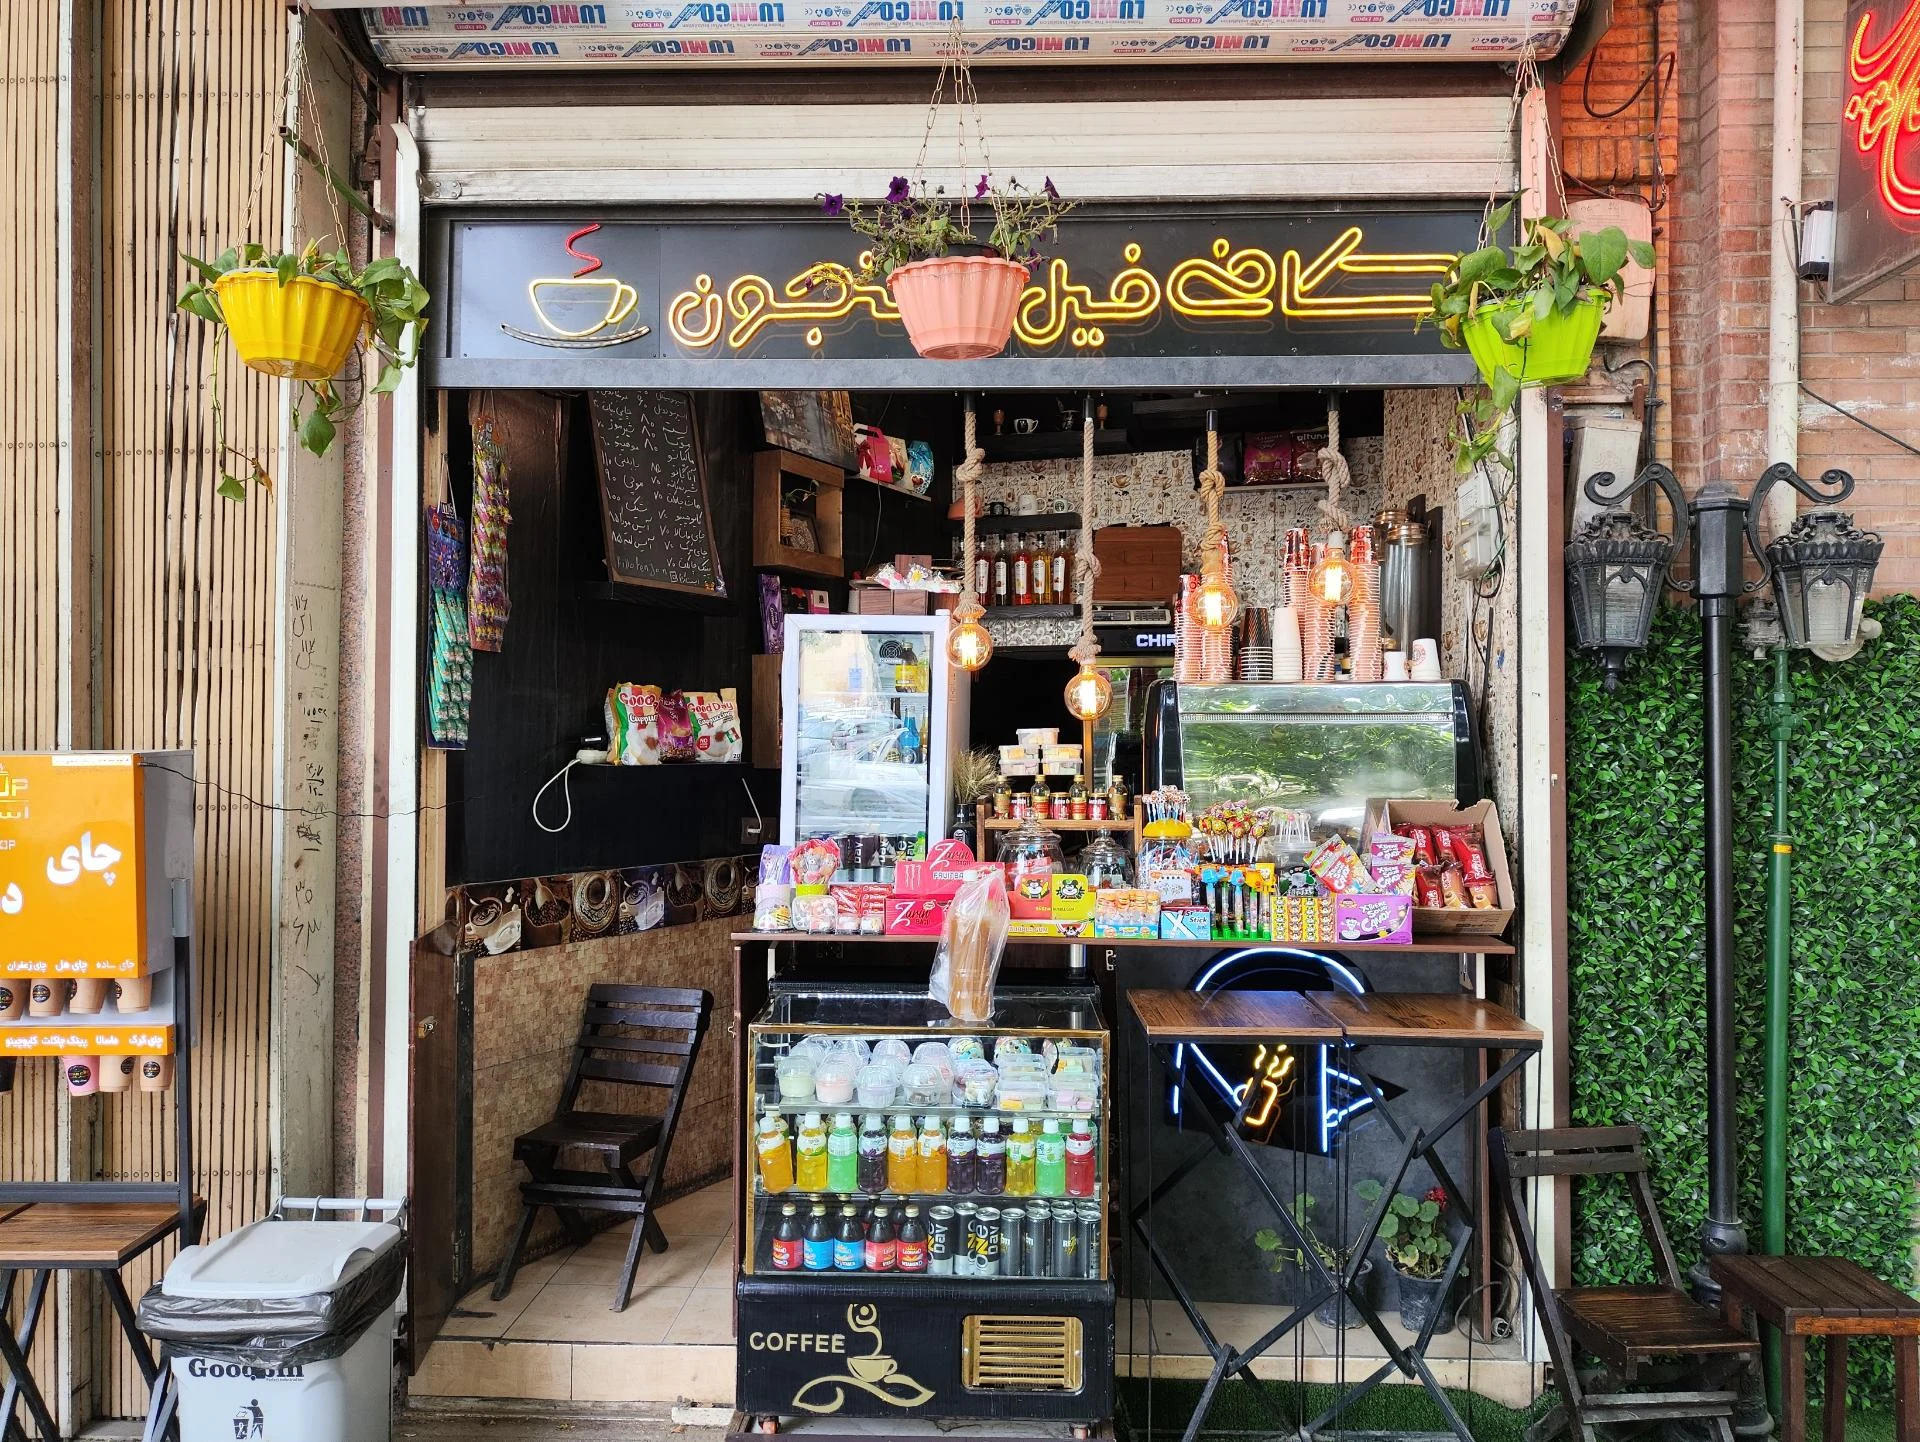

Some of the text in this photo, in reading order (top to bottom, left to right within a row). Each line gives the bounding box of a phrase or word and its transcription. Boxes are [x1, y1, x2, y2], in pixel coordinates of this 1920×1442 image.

[521, 5, 606, 25] LUMICO
[699, 3, 785, 23] LUMICO
[880, 2, 963, 22] LUMICO
[1060, 0, 1145, 20] LUMICO
[1242, 0, 1327, 18] LUMICO
[1424, 0, 1510, 17] LUMICO
[473, 42, 559, 56] LUMICO
[652, 40, 735, 54] LUMICO
[829, 39, 911, 52] LUMICO
[1007, 37, 1090, 51] LUMICO
[1185, 35, 1270, 49] LUMICO
[1367, 34, 1451, 48] LUMICO
[687, 702, 711, 713] Good
[712, 701, 734, 711] Day
[47, 831, 122, 886] چای
[891, 901, 930, 929] Zarin
[749, 1331, 846, 1354] COFFEE
